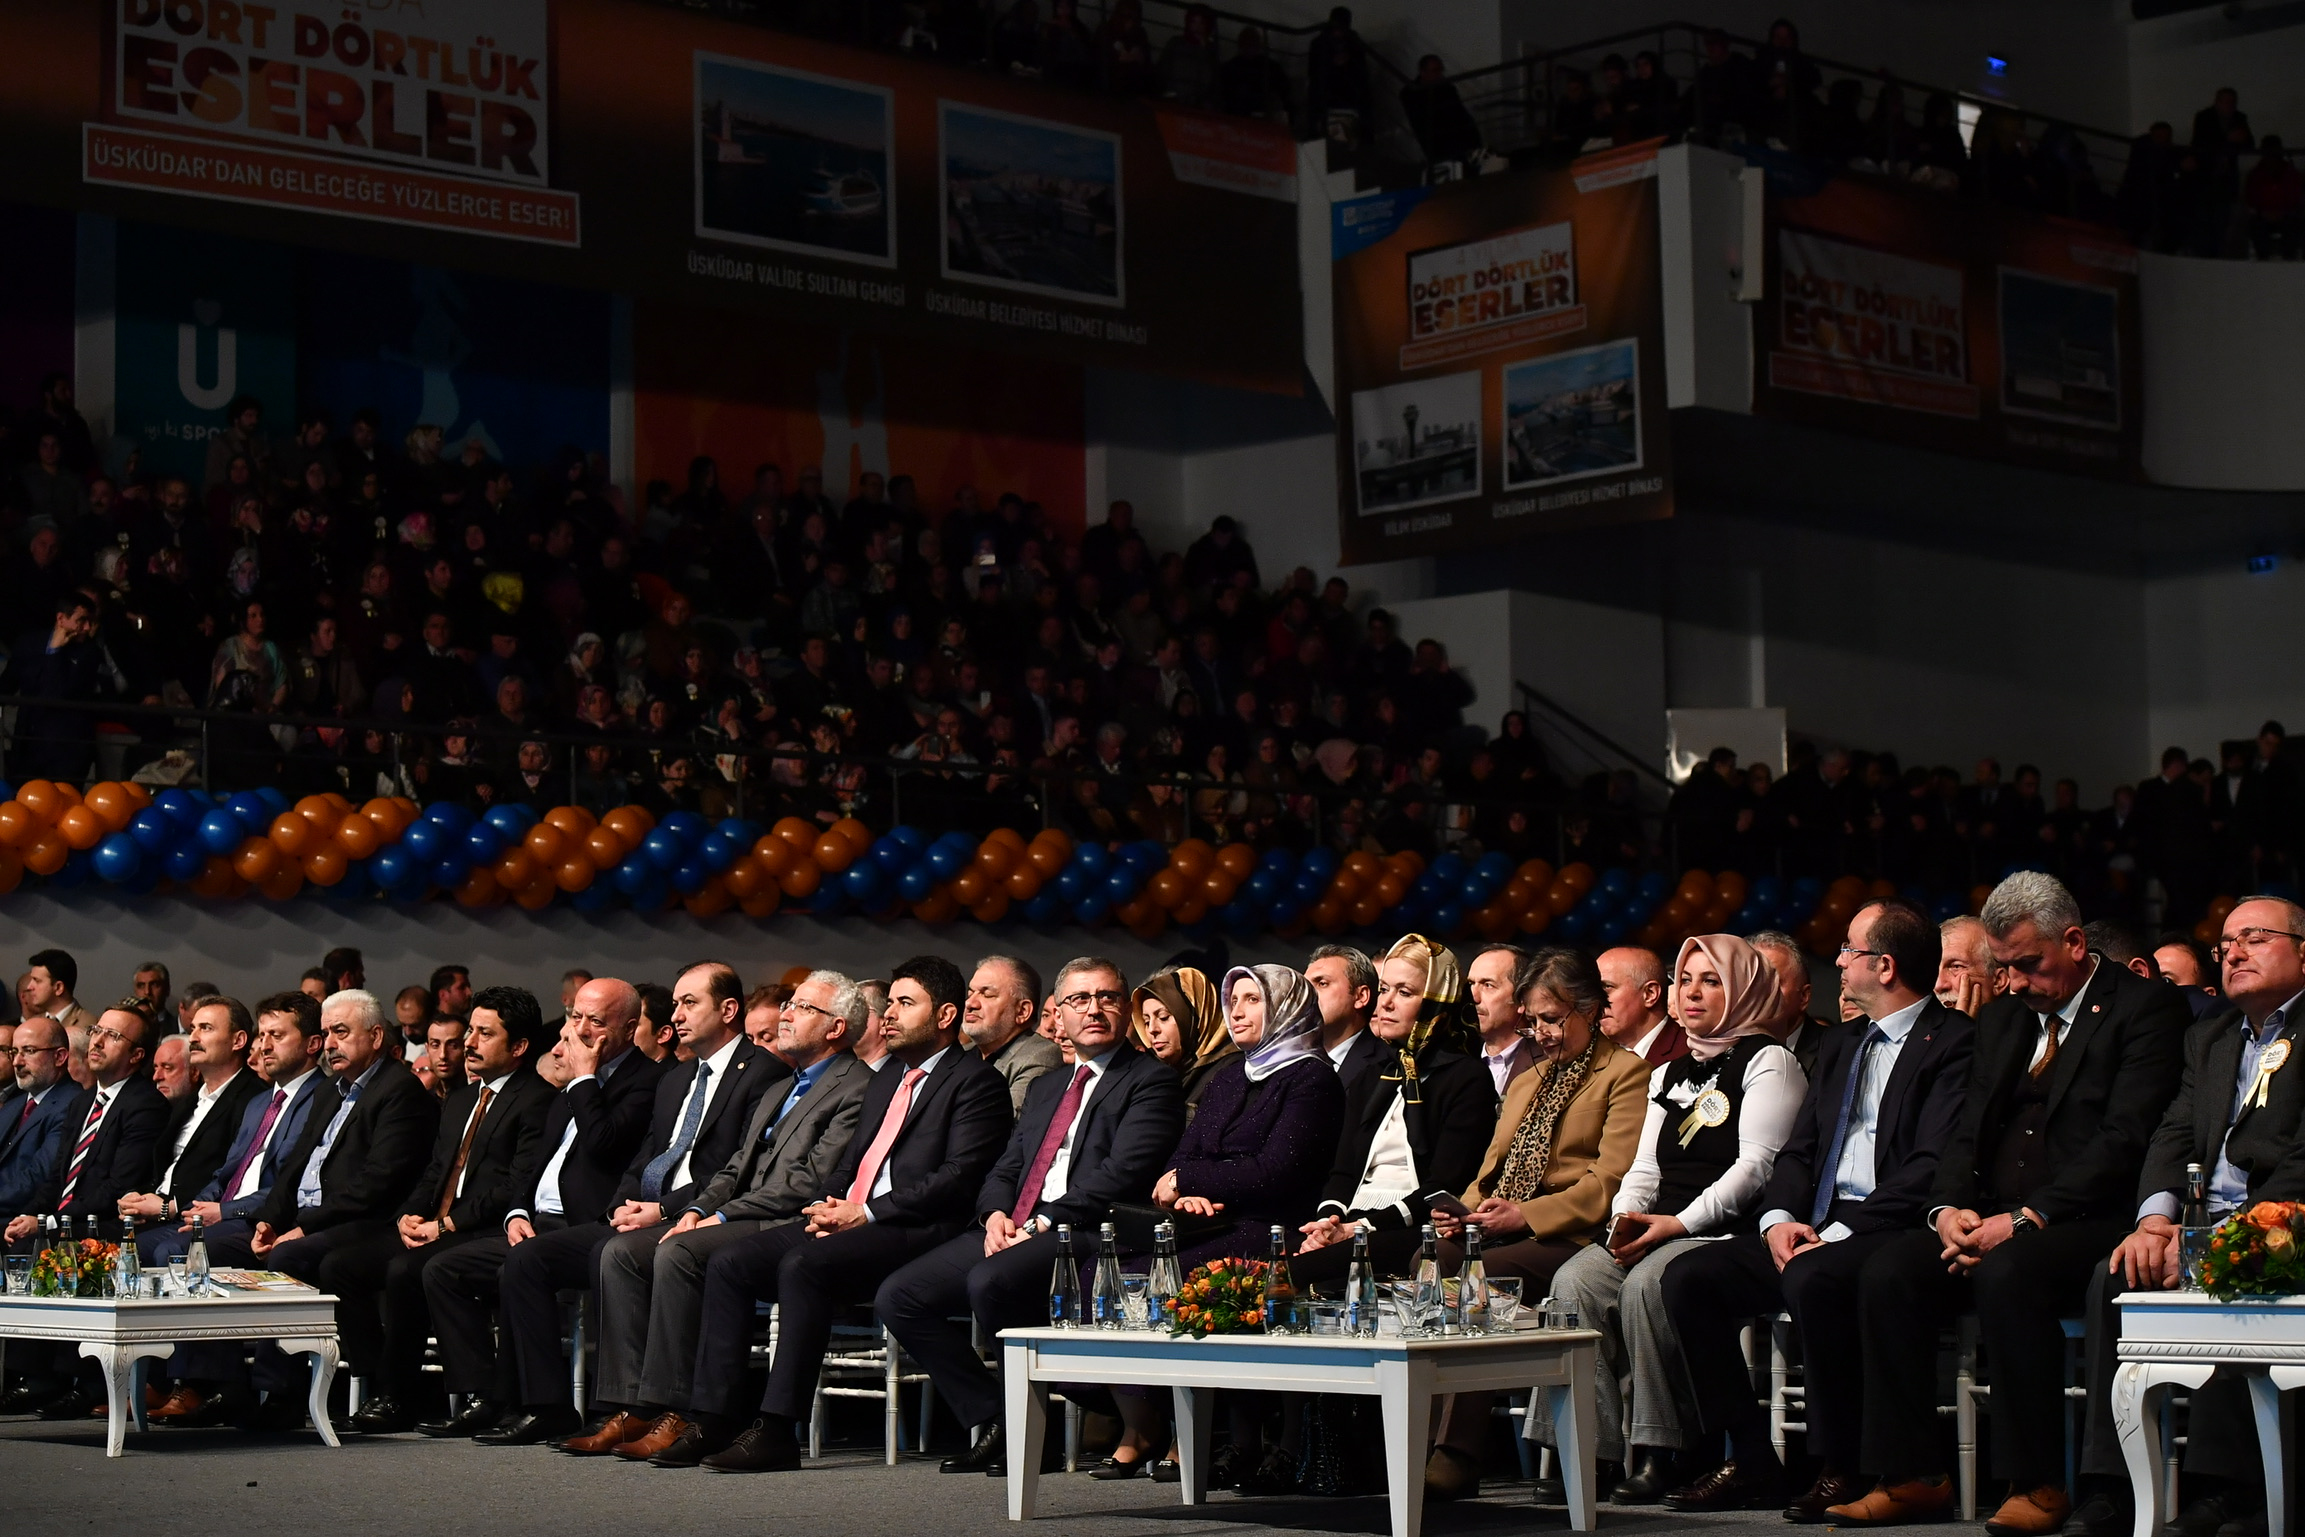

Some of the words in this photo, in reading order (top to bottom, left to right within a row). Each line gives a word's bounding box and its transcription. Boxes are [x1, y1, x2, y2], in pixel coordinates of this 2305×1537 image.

[294, 9, 540, 101] DÖRTLÜK
[124, 33, 541, 179] ESERLER
[93, 136, 263, 187] ÜSKÜDAR'DAN
[269, 166, 387, 205] GELECEĞE
[391, 180, 504, 221] YÜZLERCE
[507, 200, 572, 230] ESER!
[687, 250, 754, 283] ÜSKÜDAR
[757, 264, 805, 291] VALİDE
[807, 272, 858, 299] SULTAN
[926, 288, 987, 320] ÜSKÜDAR
[1414, 275, 1467, 301] DÖRT
[1474, 248, 1569, 290] DÖRTLÜK
[1415, 274, 1571, 336] ESERLER
